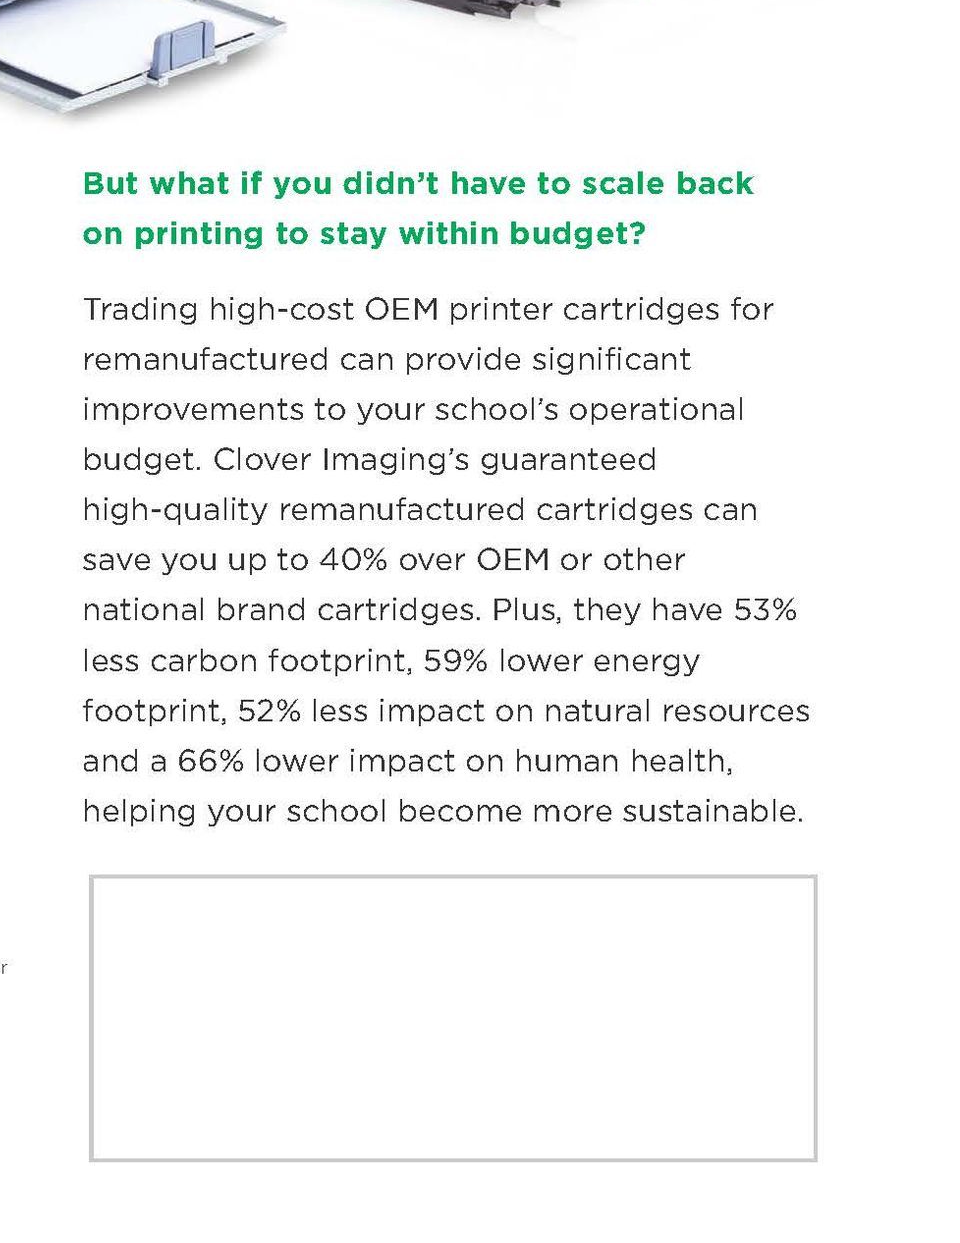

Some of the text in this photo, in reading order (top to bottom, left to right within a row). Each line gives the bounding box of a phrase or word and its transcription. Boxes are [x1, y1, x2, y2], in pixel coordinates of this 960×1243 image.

[84, 169, 755, 200] But what if you didn’t have to scale back
[82, 220, 646, 250] on printing to stay within budget?
[84, 496, 757, 526] high-quality remanufactured cartridges can
[82, 546, 686, 576] save you up to 40% over OEM or other
[84, 596, 797, 626] national brand cartridges. Plus, they have 53%
